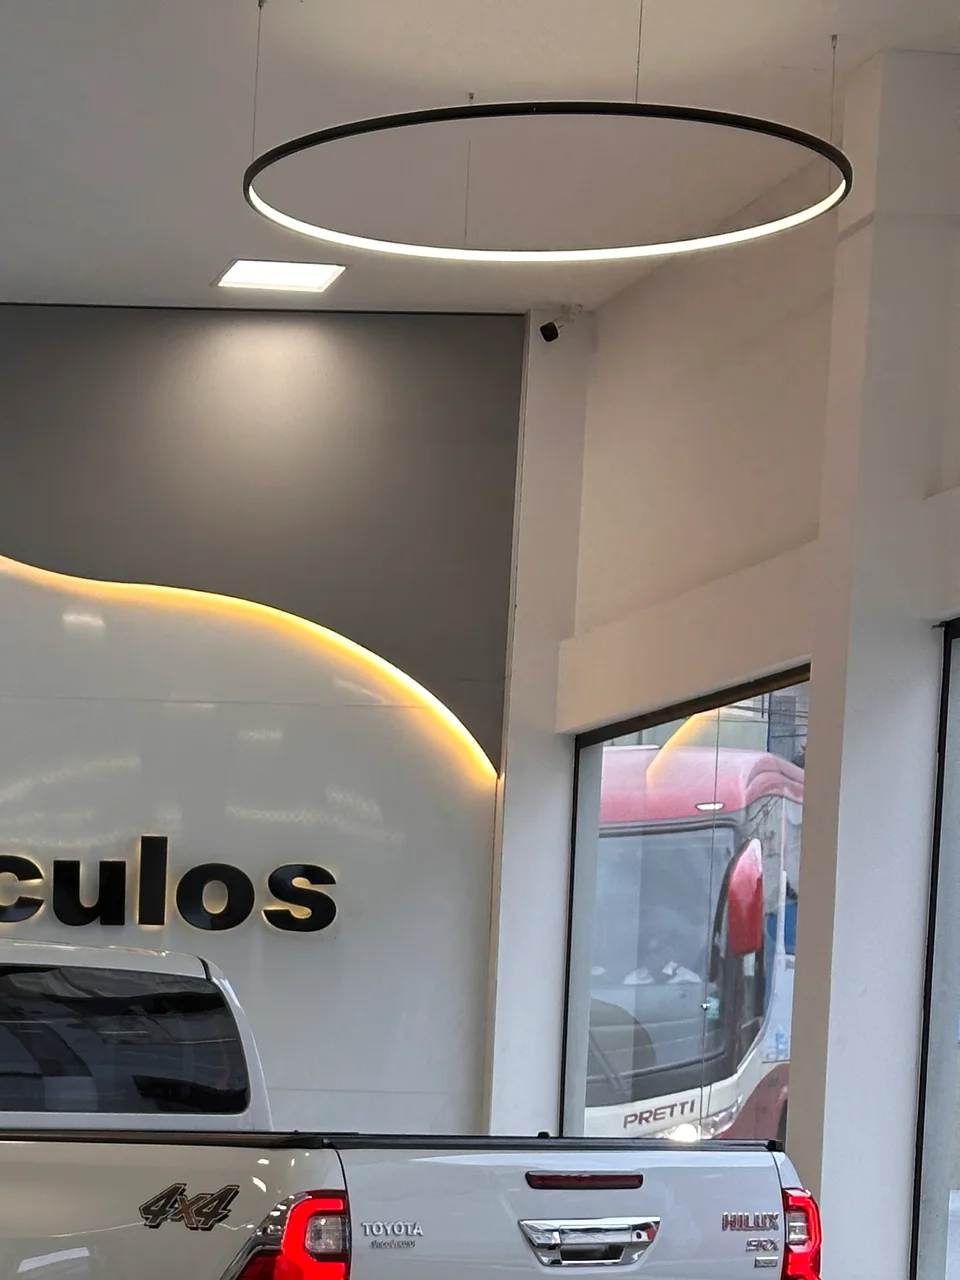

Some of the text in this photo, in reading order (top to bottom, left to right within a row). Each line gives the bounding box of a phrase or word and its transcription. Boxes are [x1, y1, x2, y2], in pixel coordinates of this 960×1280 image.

[623, 1099, 696, 1129] PRETTI
[361, 1221, 424, 1236] TOYOTA
[722, 1211, 779, 1231] HILUX
[745, 1237, 780, 1252] SRX
